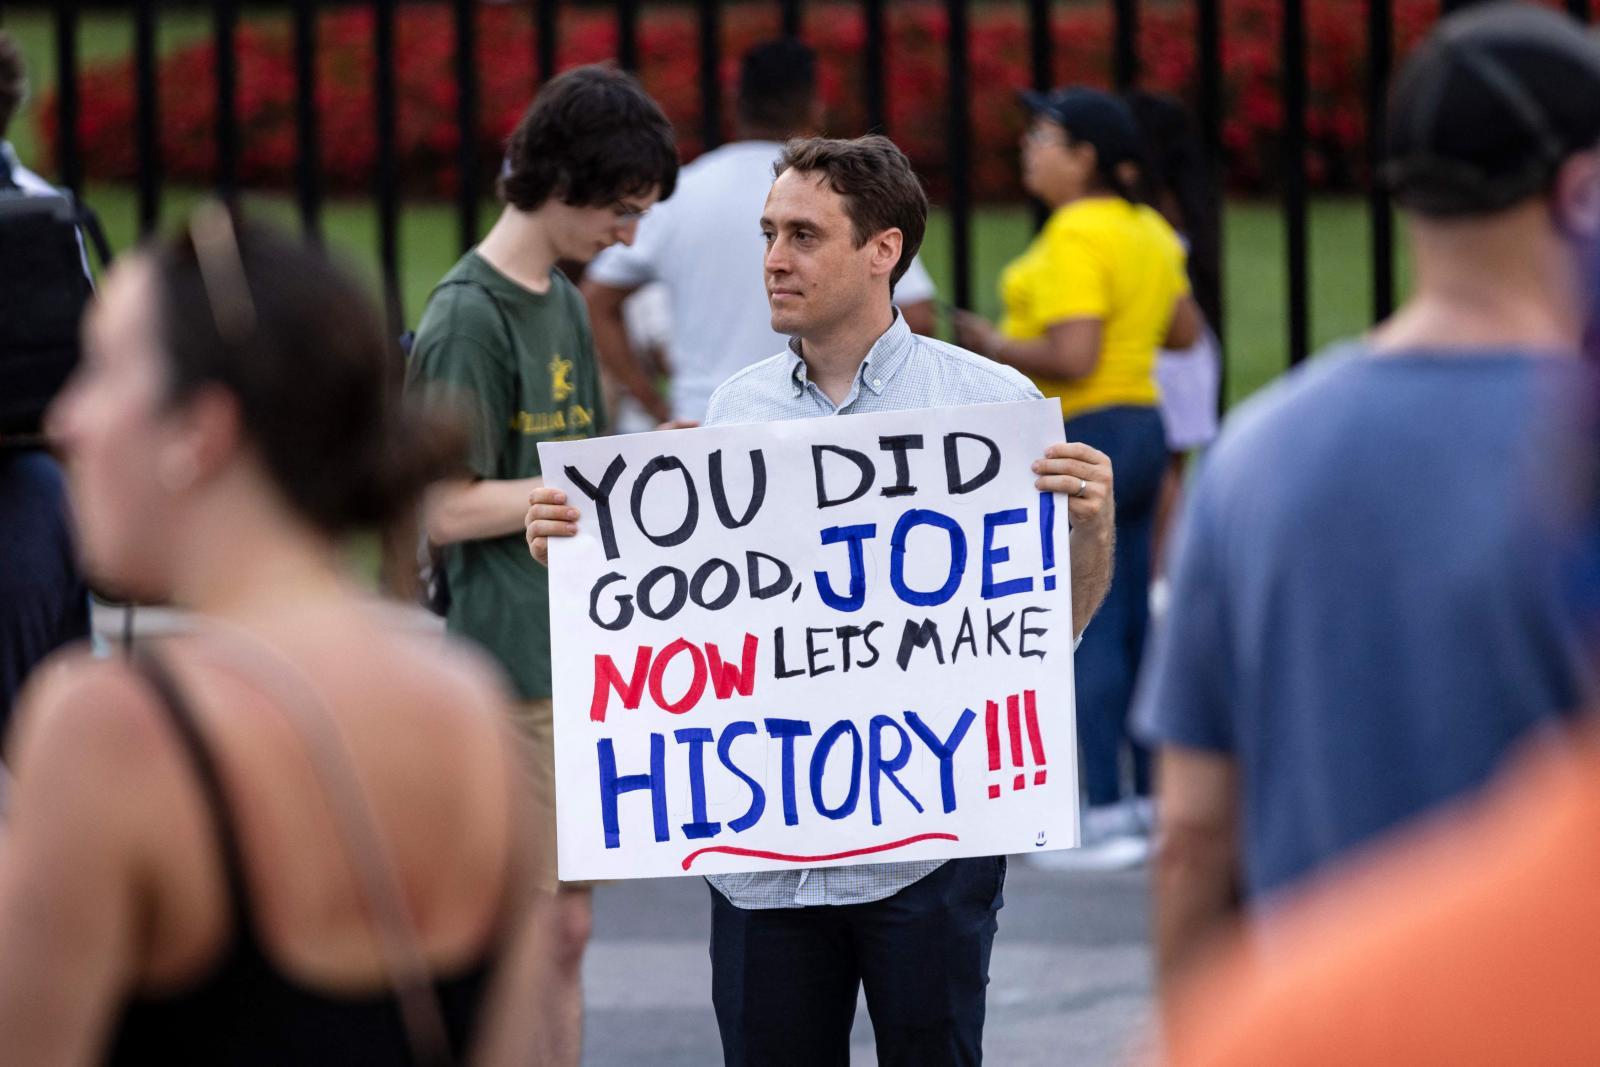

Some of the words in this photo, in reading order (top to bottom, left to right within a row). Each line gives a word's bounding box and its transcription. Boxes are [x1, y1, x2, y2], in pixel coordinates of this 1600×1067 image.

[563, 448, 767, 561] YOU
[811, 431, 1002, 509] DID
[588, 550, 803, 631] GOOD,
[813, 491, 1057, 613] JOE!
[589, 632, 759, 723] NOW
[774, 620, 885, 680] LETS
[896, 606, 1053, 672] MAKE
[596, 689, 1048, 849] HISTORY!!!
